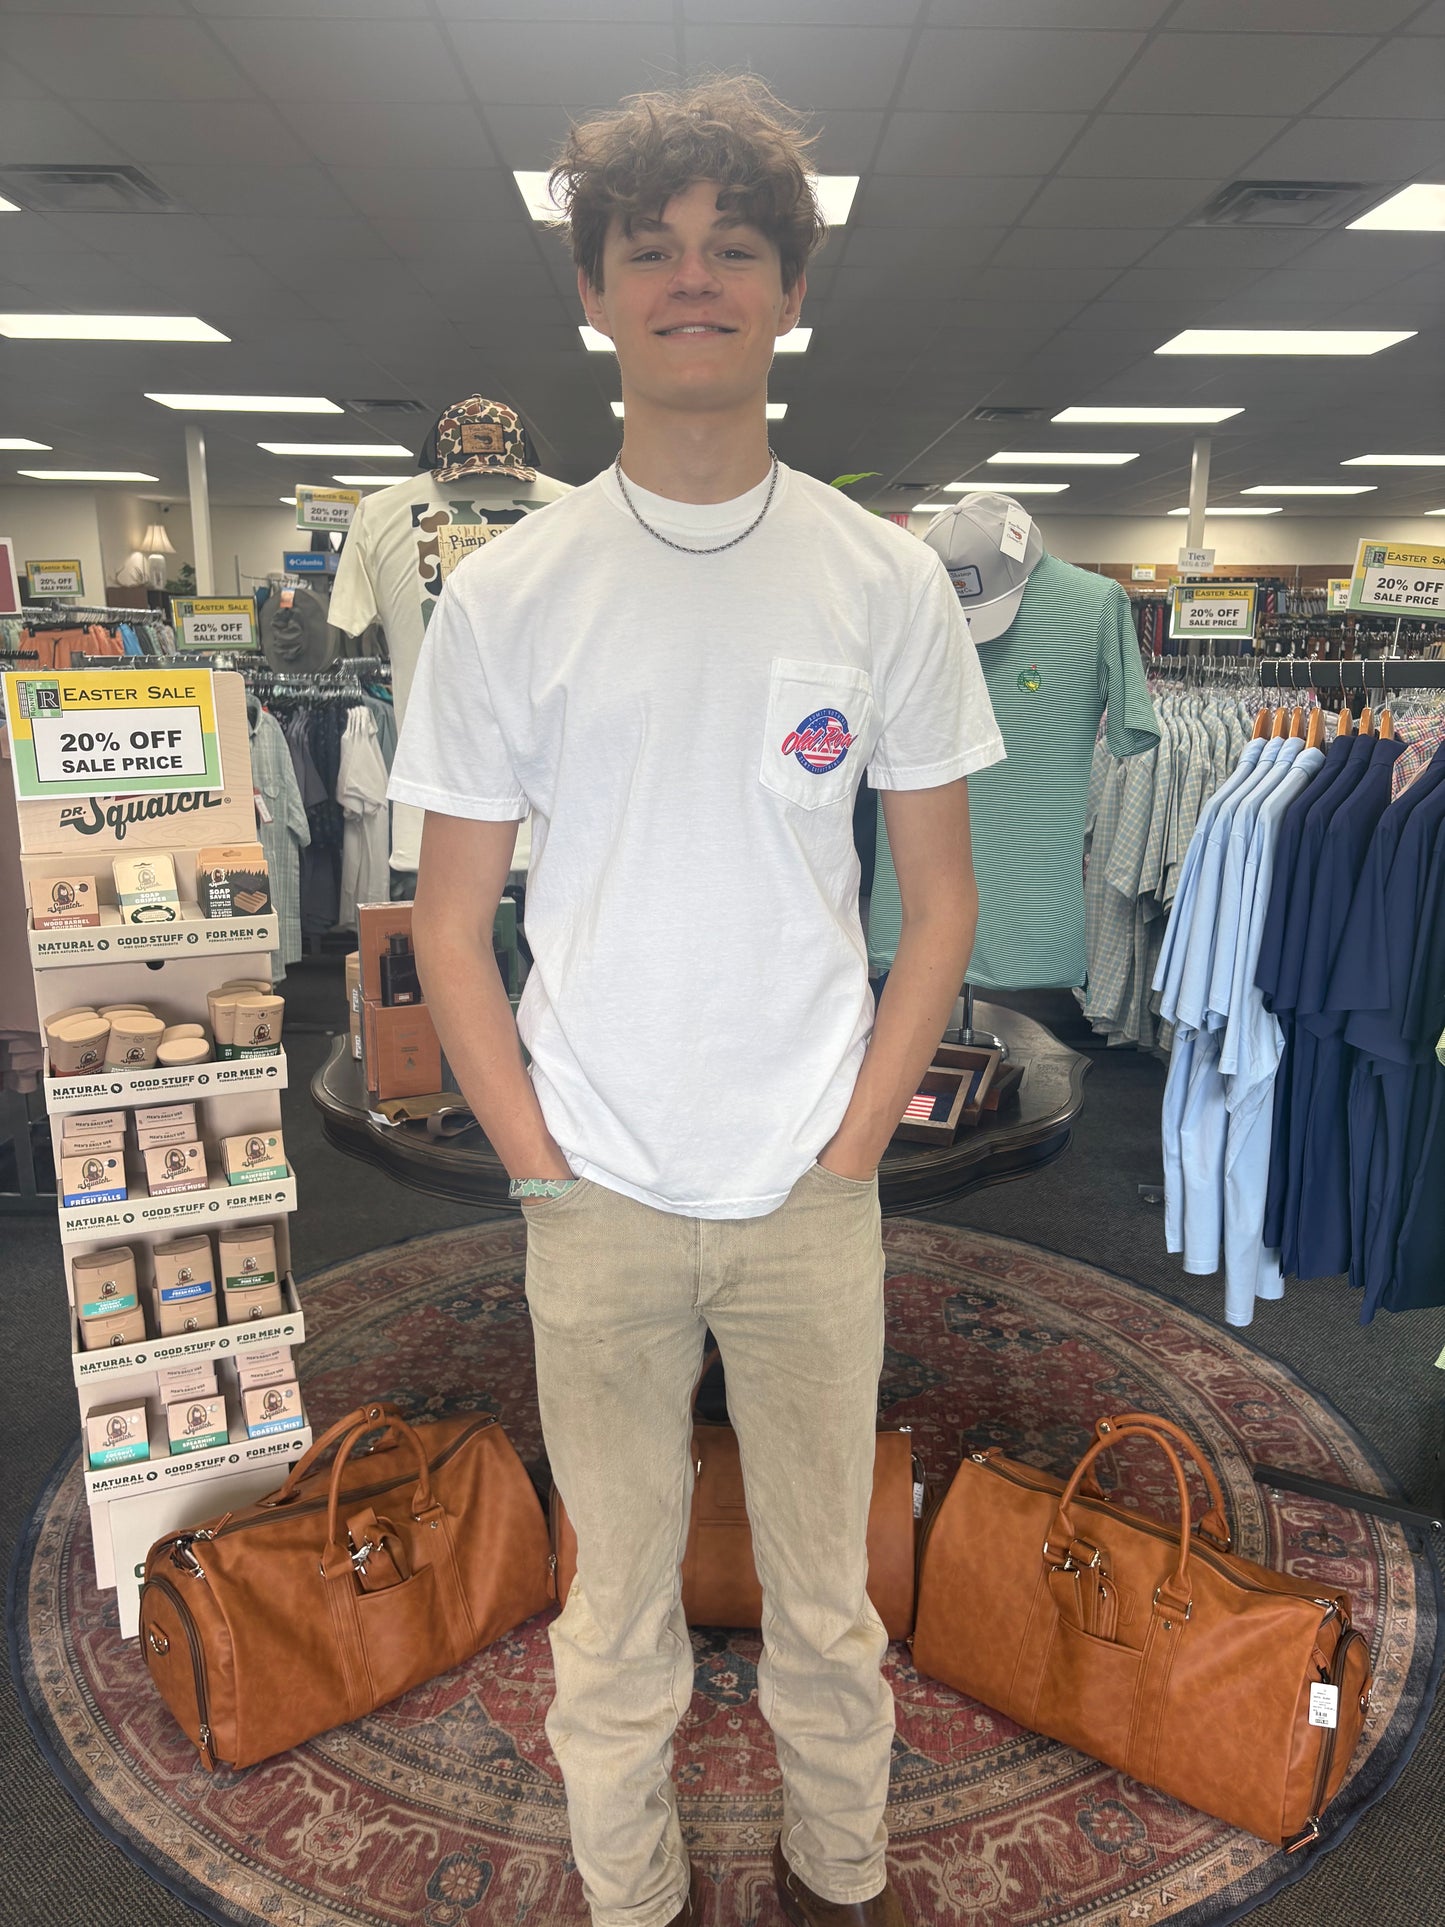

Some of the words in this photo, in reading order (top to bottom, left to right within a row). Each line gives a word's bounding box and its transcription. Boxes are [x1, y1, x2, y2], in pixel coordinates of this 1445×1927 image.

[311, 507, 330, 515] 20%
[332, 508, 348, 516] OFF
[449, 534, 487, 550] Pimp
[1188, 552, 1206, 560] Ties
[1387, 552, 1427, 563] EASTER
[1377, 577, 1408, 591] 20%
[1414, 581, 1444, 593] OFF
[1374, 592, 1402, 602] SALE
[1406, 595, 1439, 606] PRICE
[1190, 609, 1214, 618] 20%
[1217, 609, 1240, 617] OFF
[193, 624, 217, 632] 20%
[221, 623, 242, 632] OFF
[27, 683, 36, 716] RONNIE'S
[38, 690, 60, 708] R
[64, 688, 137, 701] EASTER
[148, 686, 196, 699] SALE
[60, 732, 120, 752] 20%
[129, 730, 182, 749] OFF
[782, 728, 824, 755] Old
[818, 726, 858, 754] Row
[62, 758, 115, 773] SALE
[122, 756, 183, 770] PRICE
[60, 806, 86, 818] DR.
[60, 791, 222, 840] Squatch
[48, 901, 82, 914] Squatch
[117, 936, 148, 945] GOOD
[149, 934, 183, 943] STUFF
[206, 930, 227, 939] FOR
[230, 929, 254, 937] MEN
[38, 940, 94, 951] NATURAL
[216, 1071, 238, 1079] FOR
[240, 1068, 263, 1076] MEN
[130, 1079, 160, 1088] GOOD
[161, 1076, 195, 1085] STUFF
[52, 1084, 107, 1096] NATURAL
[152, 1186, 187, 1196] MAVERICK
[70, 1198, 96, 1206] FRESH
[226, 1197, 246, 1206] FOR
[250, 1193, 272, 1202] MEN
[142, 1208, 171, 1217] GOOD
[173, 1203, 205, 1213] STUFF
[66, 1215, 120, 1228] NATURAL
[237, 1333, 256, 1342] FOR
[259, 1328, 280, 1337] MEN
[154, 1347, 182, 1357] GOOD
[184, 1340, 215, 1352] STUFF
[80, 1357, 132, 1371] NATURAL
[251, 1425, 282, 1437] COASTAL
[283, 1421, 300, 1431] MIST
[182, 1436, 216, 1448] SPEARMINT
[246, 1448, 266, 1457] FOR
[268, 1443, 289, 1452] MEN
[165, 1464, 193, 1474] GOOD
[194, 1456, 226, 1468] STUFF
[92, 1474, 143, 1489] NATURAL
